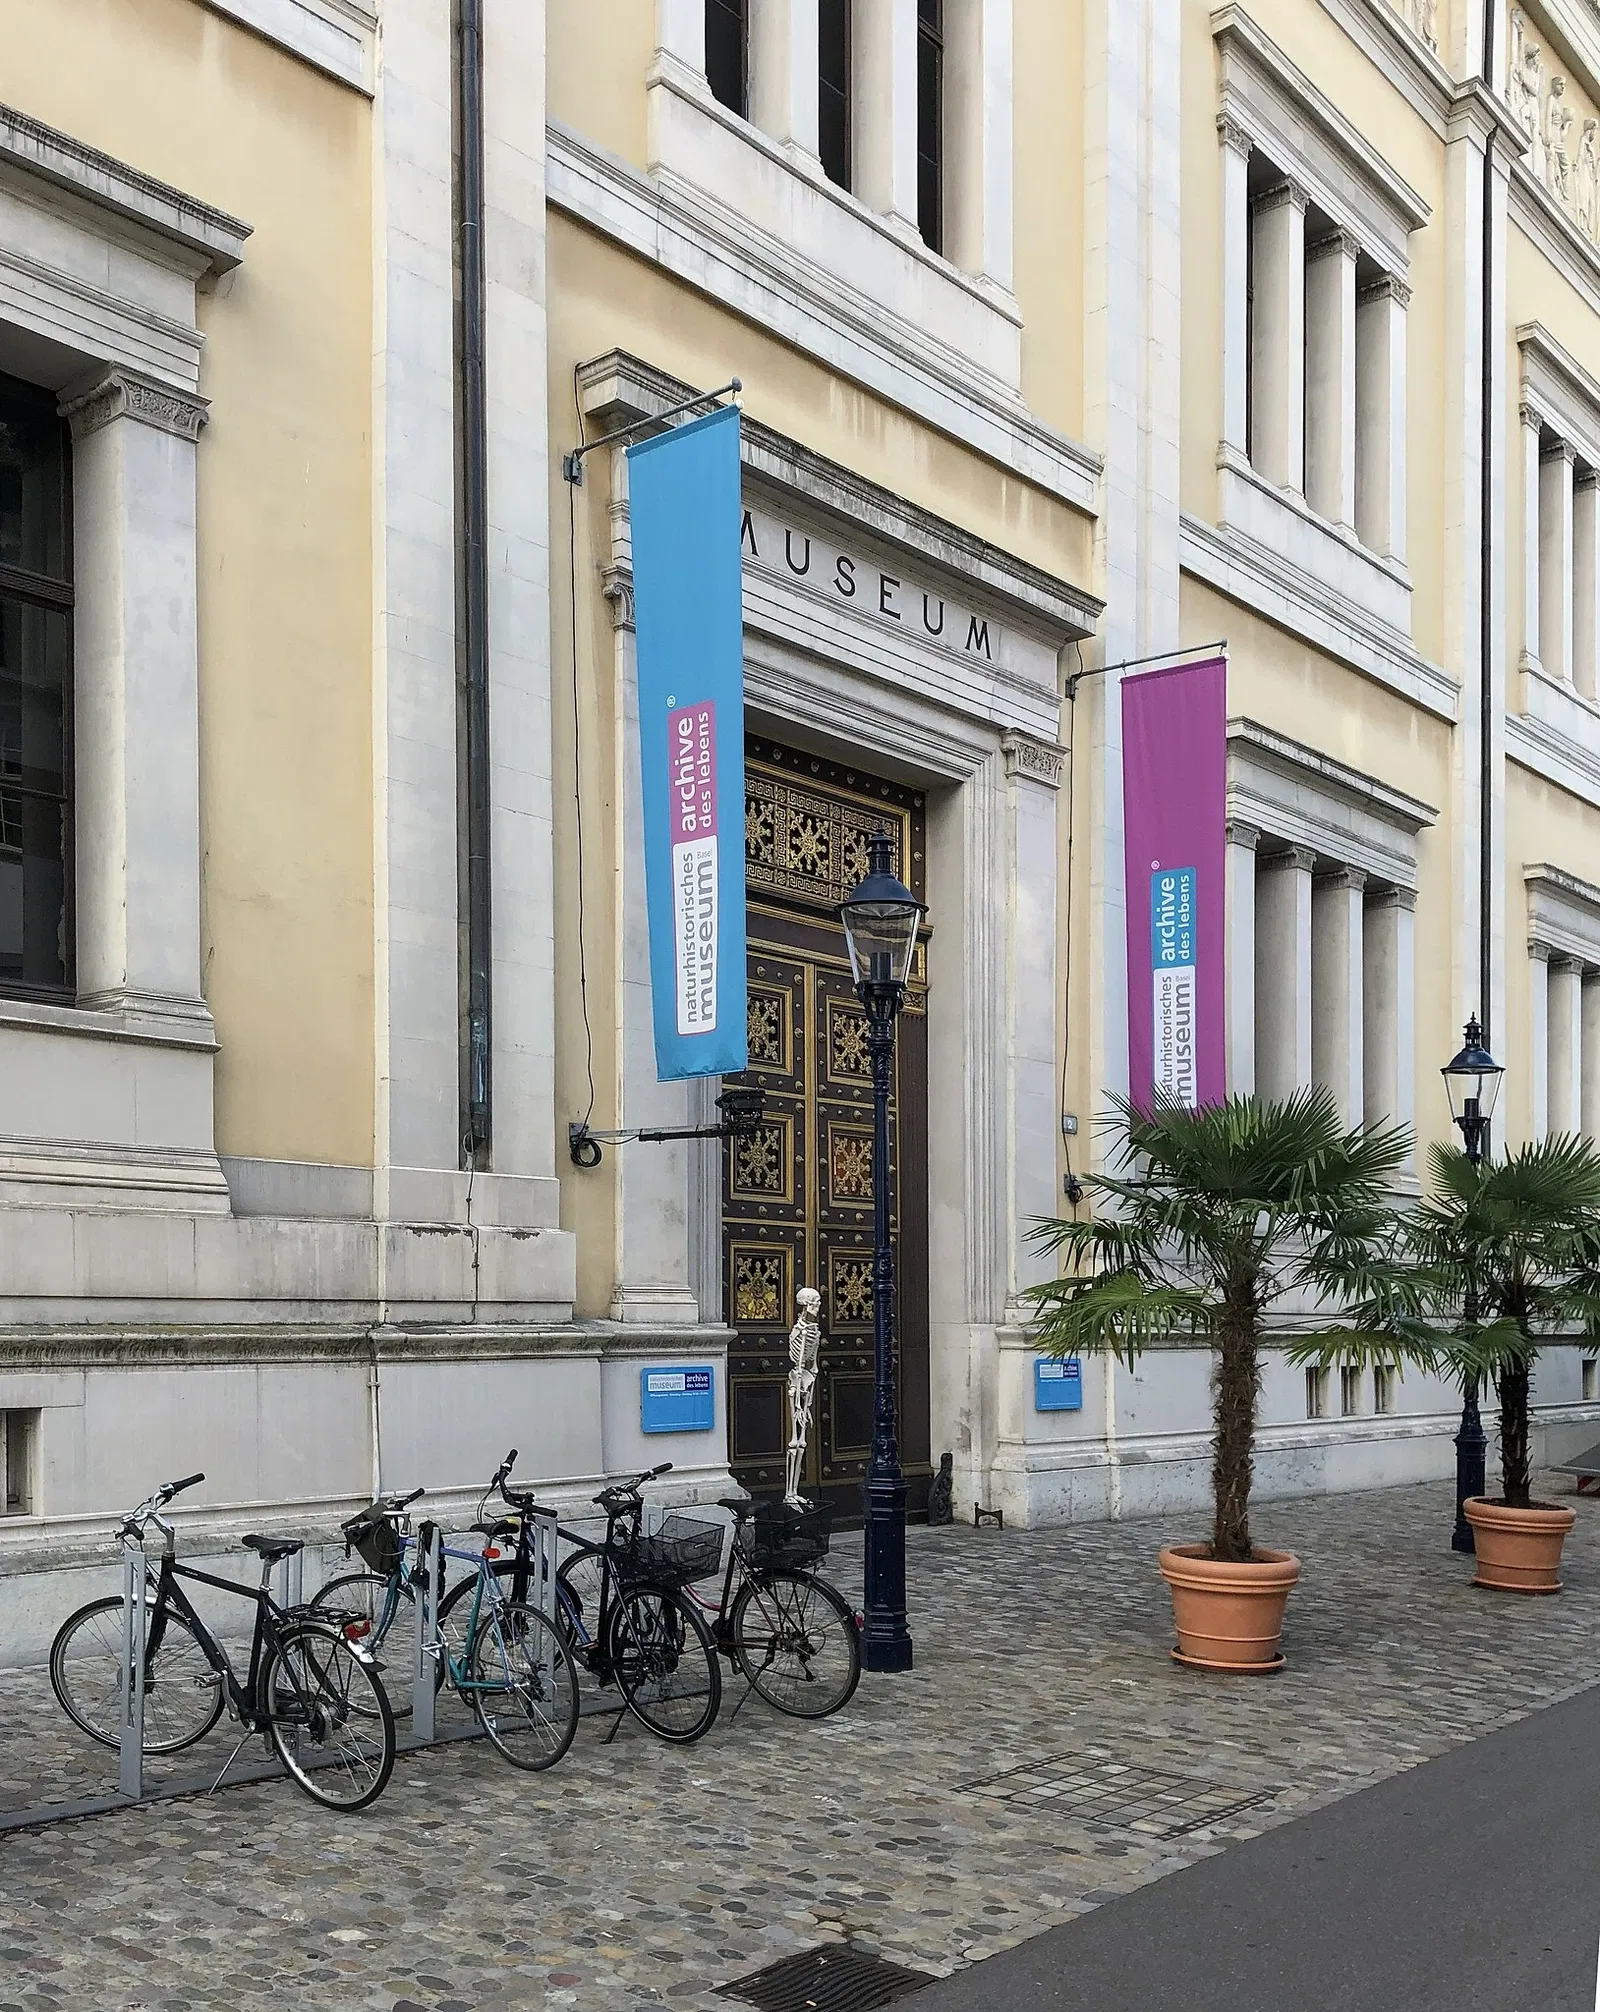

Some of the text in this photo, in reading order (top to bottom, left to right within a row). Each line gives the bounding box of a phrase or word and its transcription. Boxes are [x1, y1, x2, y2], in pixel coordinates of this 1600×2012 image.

[675, 717, 697, 832] archive
[697, 711, 712, 828] des lebens
[680, 852, 697, 1023] naturhistorisches
[697, 860, 713, 1021] museum
[1156, 877, 1176, 961] archive
[1178, 874, 1190, 960] des lebens
[1176, 983, 1192, 1100] museum
[650, 1381, 681, 1390] museum
[686, 1374, 708, 1382] archive
